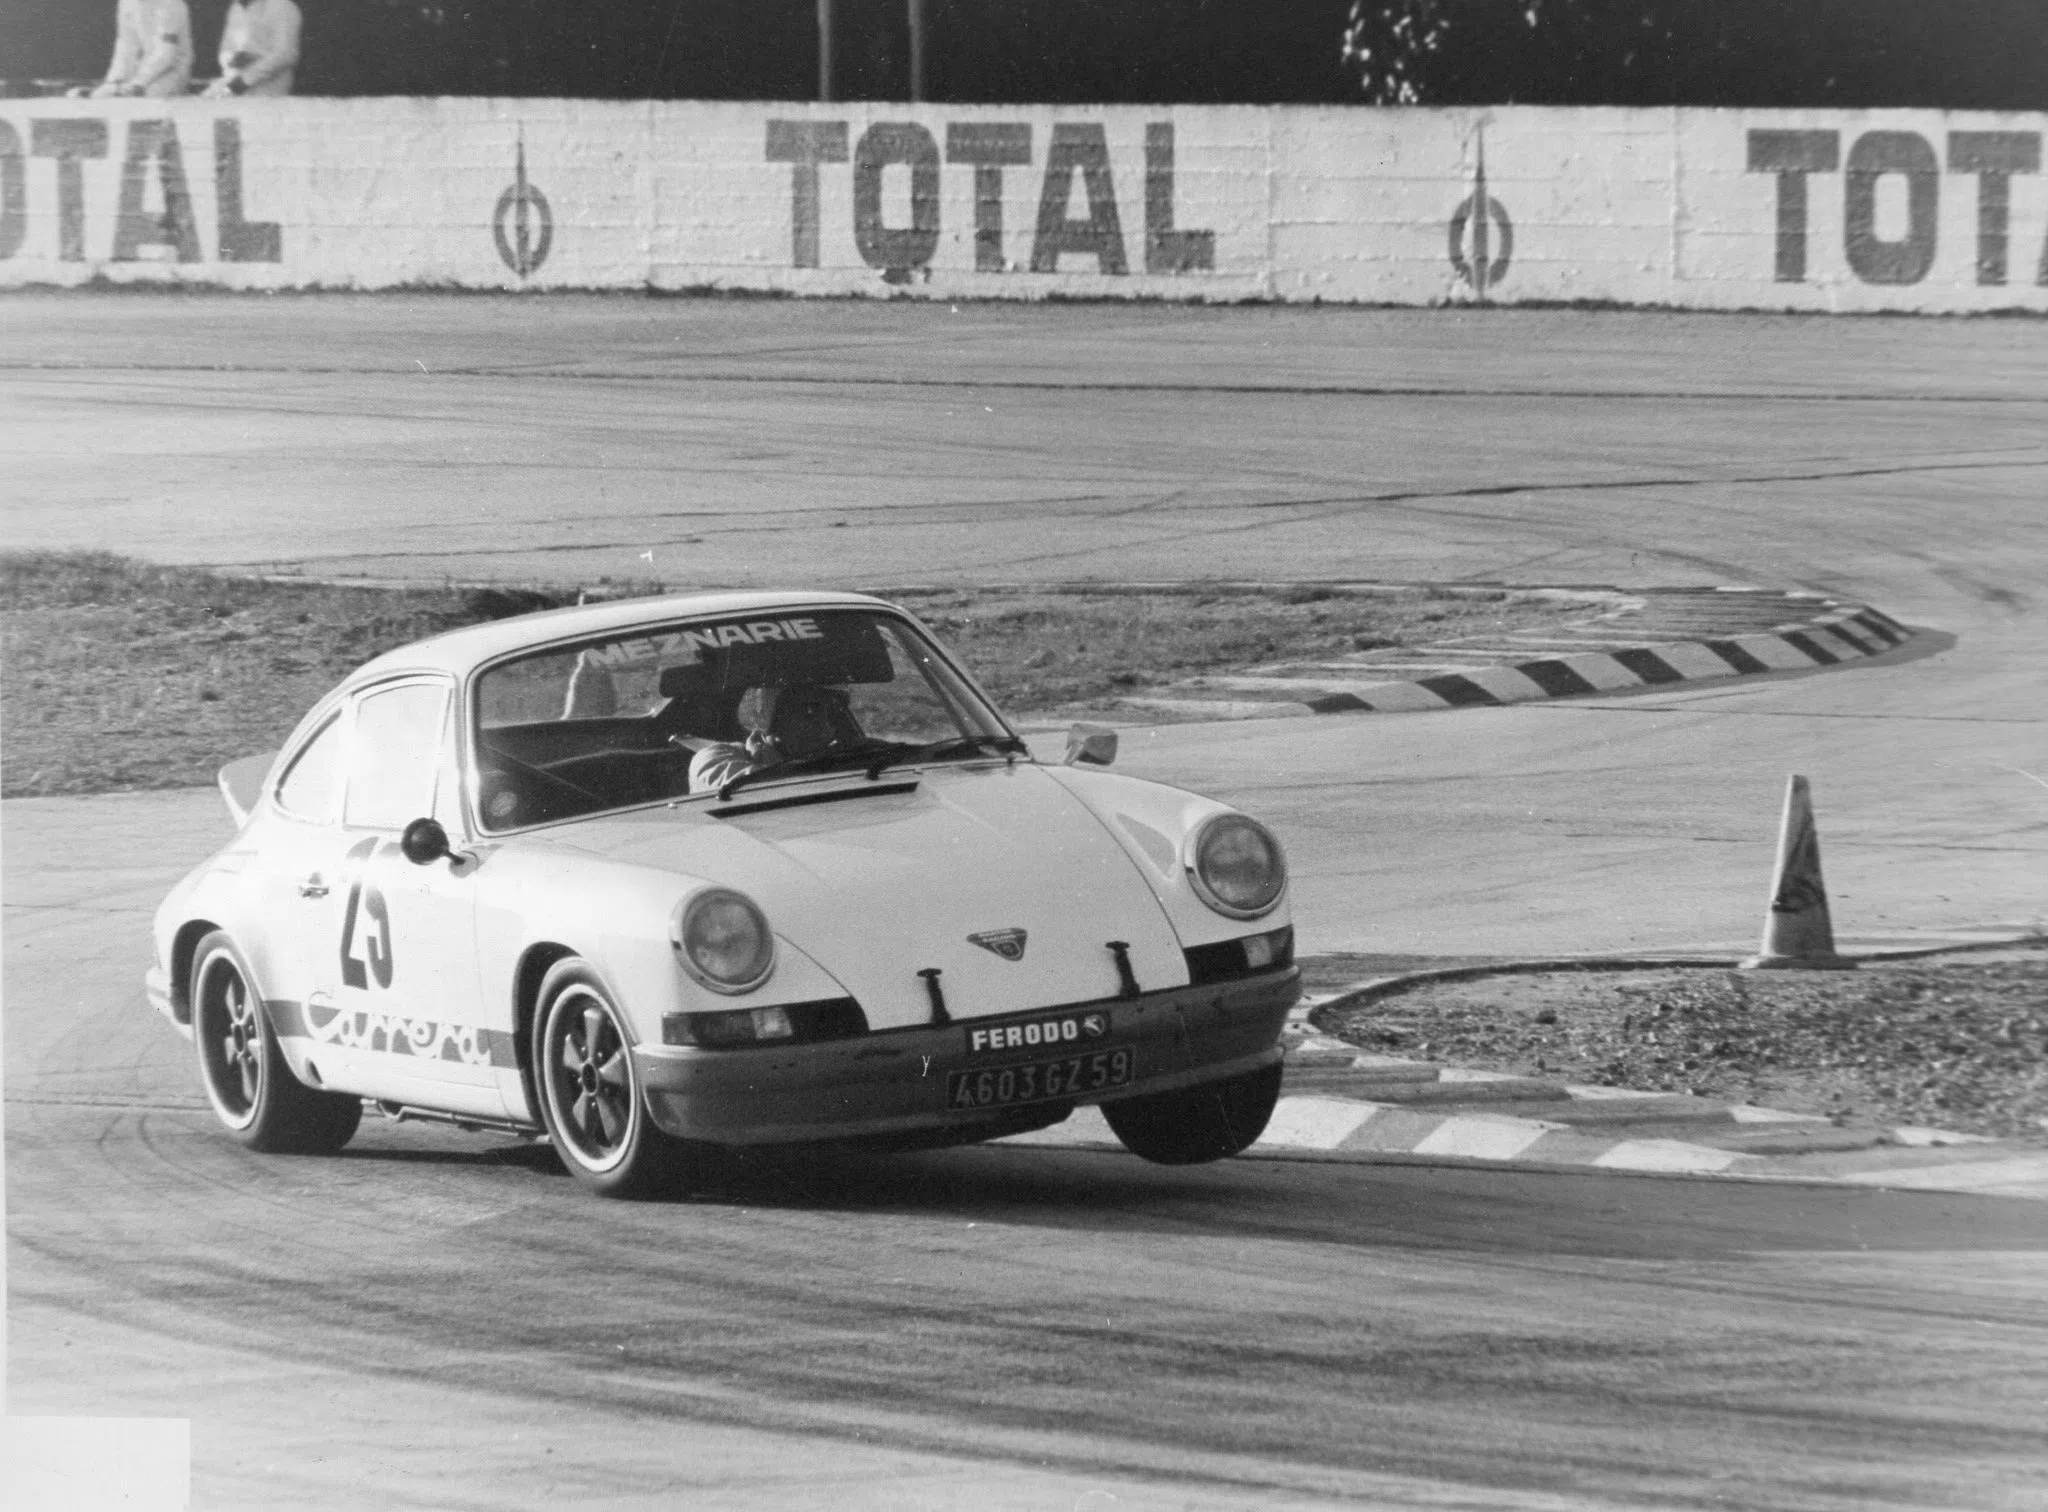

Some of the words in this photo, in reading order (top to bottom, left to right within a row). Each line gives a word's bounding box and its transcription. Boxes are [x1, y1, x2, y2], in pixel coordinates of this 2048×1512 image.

[765, 119, 1215, 275] TOTAL
[1746, 128, 2048, 286] TOT
[584, 618, 825, 668] MEZNARIE
[300, 990, 492, 1067] Carrera
[971, 1019, 1079, 1051] FERODO
[955, 1066, 1037, 1105] 4603
[1045, 1060, 1082, 1095] GZ
[1091, 1051, 1128, 1086] 59
